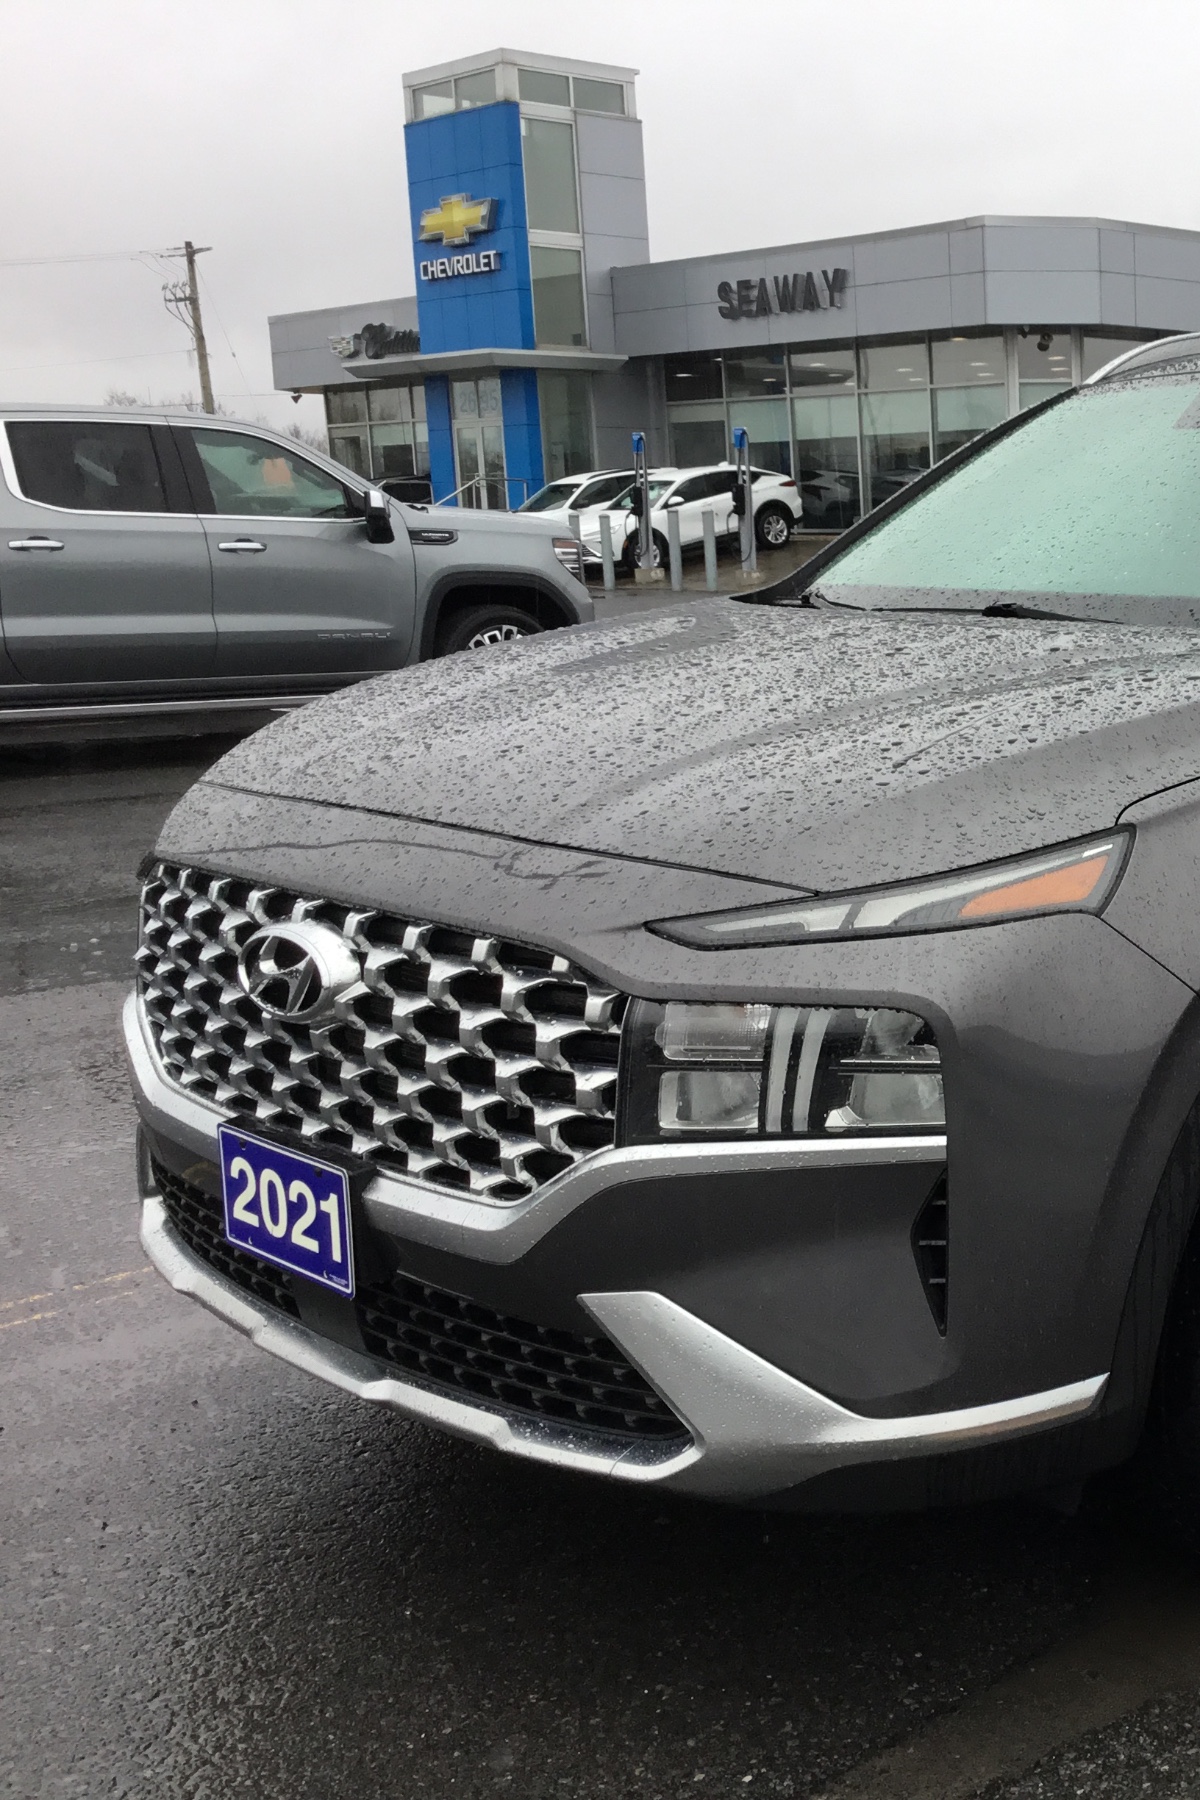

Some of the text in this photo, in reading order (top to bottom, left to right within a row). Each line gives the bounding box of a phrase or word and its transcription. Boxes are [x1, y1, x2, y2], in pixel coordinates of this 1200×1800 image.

[420, 250, 498, 281] CHEVROLET
[717, 268, 847, 320] SEAWAY
[230, 1156, 342, 1264] 2021
